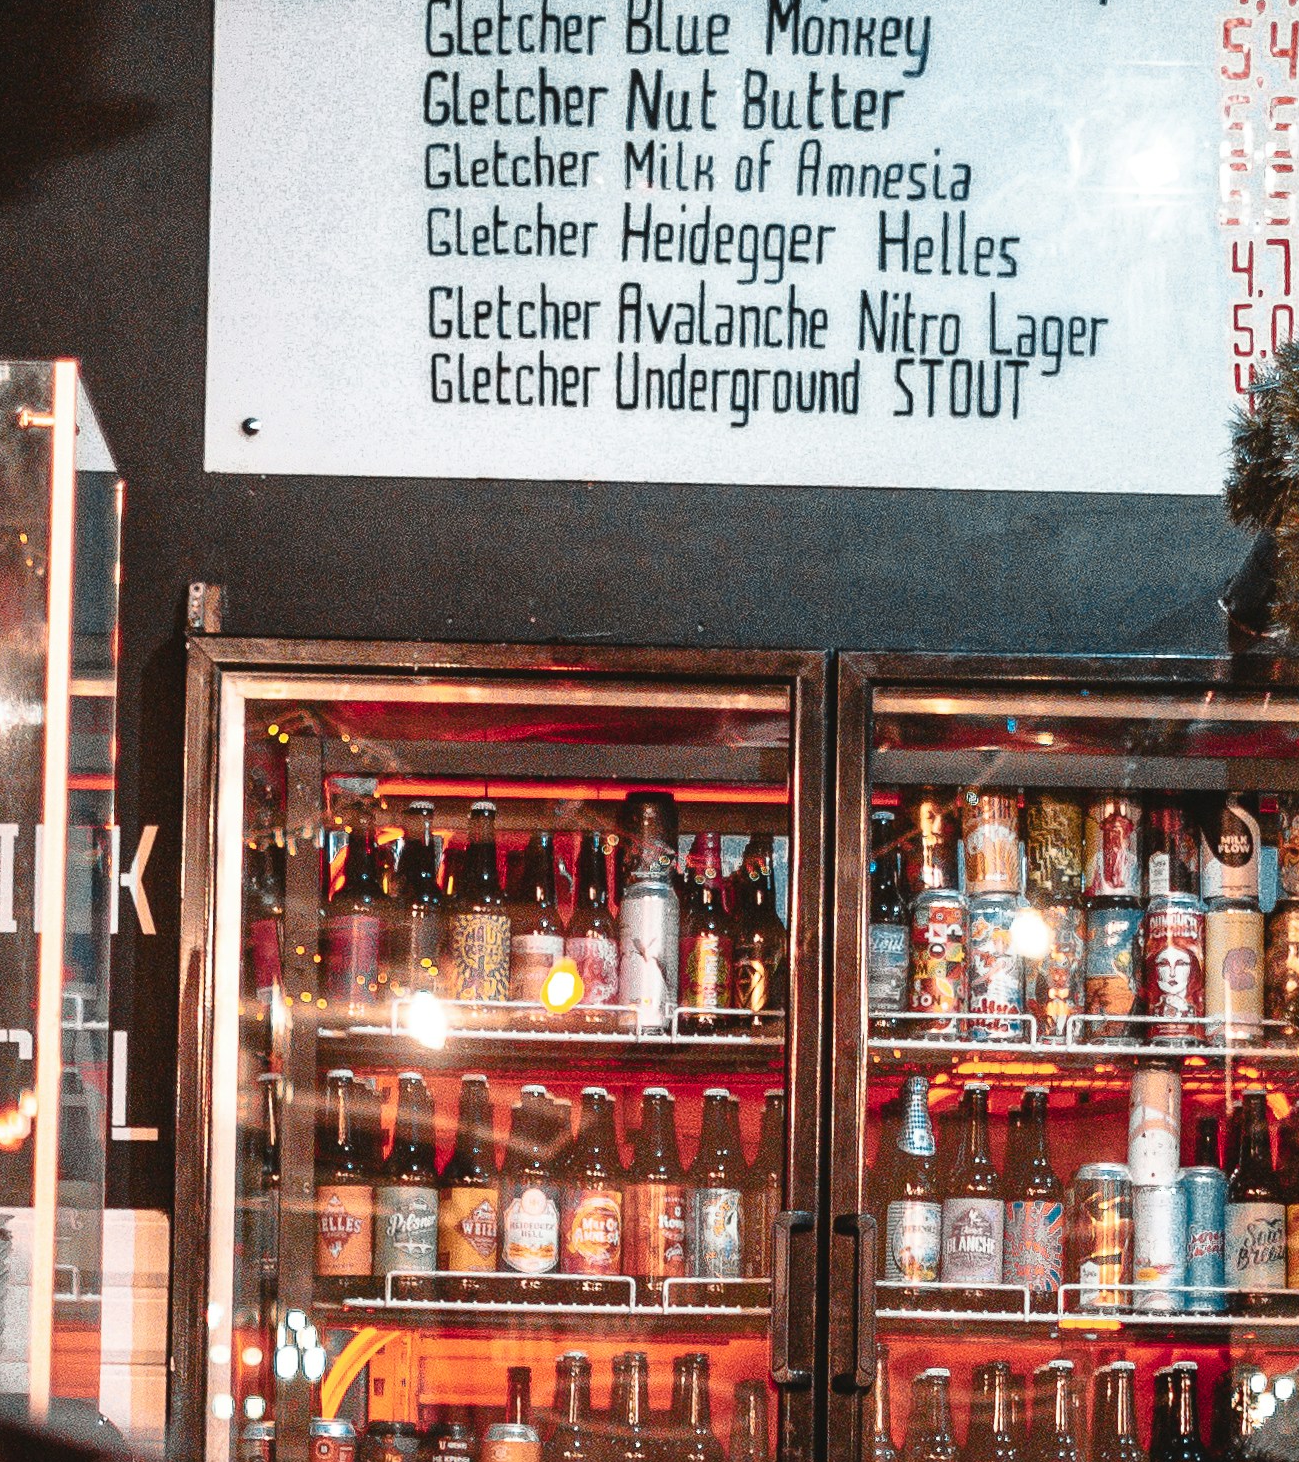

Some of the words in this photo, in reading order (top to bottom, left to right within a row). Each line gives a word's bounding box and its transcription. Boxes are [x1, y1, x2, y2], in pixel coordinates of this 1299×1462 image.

[422, 67, 609, 128] Gletcher
[624, 68, 717, 132] Nut
[742, 68, 906, 132] Butter
[424, 136, 600, 191] Gletcher
[624, 139, 714, 191] Milk
[734, 138, 774, 193] of
[796, 139, 973, 202] Amnesia
[426, 202, 599, 258] Gletcher
[621, 202, 836, 285] Heidegger
[877, 210, 1021, 279] Helles
[428, 282, 601, 341] Gletcher
[618, 280, 829, 349] Avalanche
[858, 289, 961, 356] Nitro
[989, 302, 1110, 380] Lager
[429, 350, 601, 408] Gletcher
[615, 351, 861, 429] Underground
[892, 358, 1028, 420] STOUT
